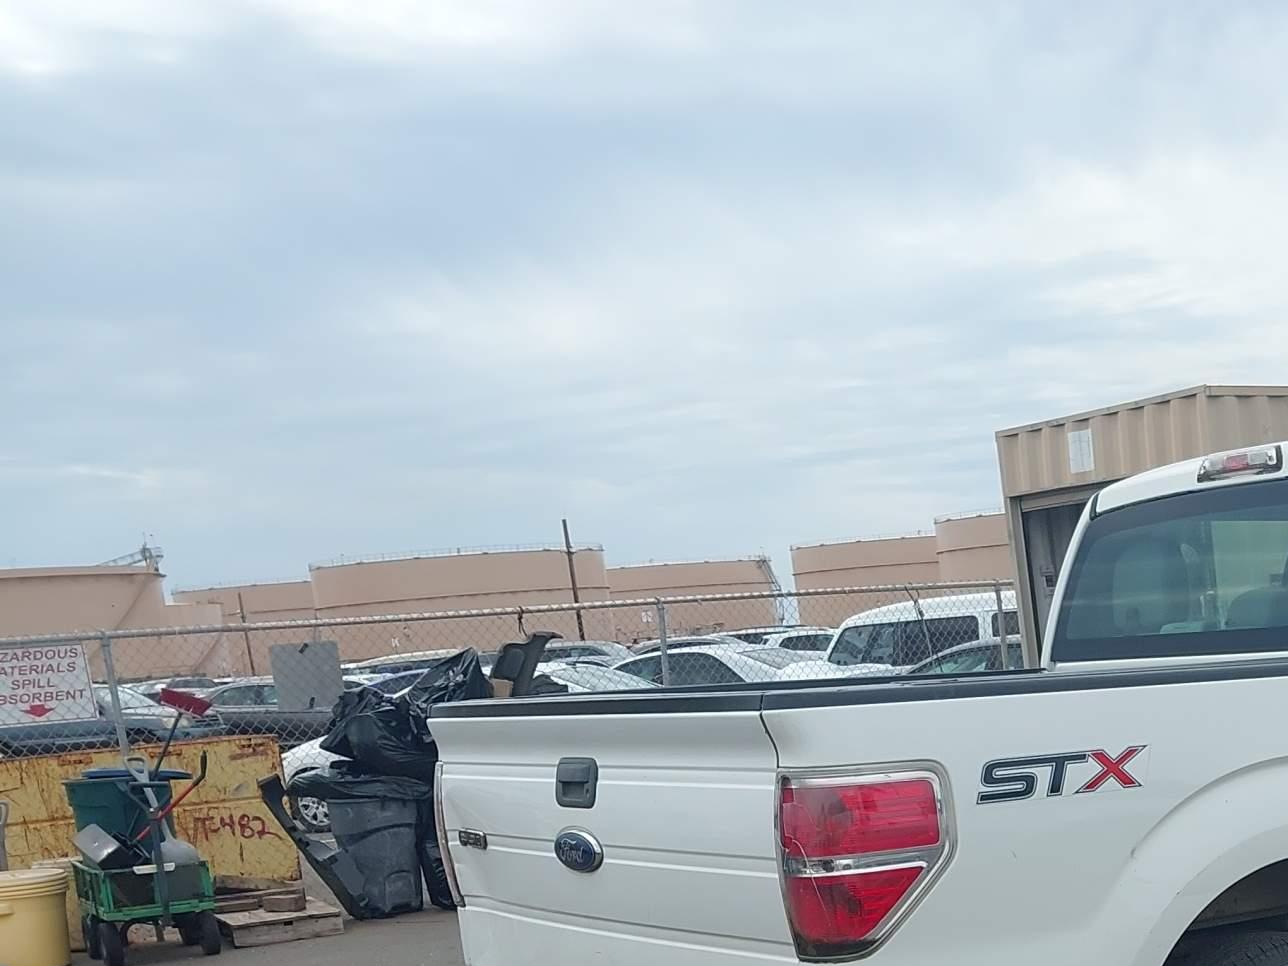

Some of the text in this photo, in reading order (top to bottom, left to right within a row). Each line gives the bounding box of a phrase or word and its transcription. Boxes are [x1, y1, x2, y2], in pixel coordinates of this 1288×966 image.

[11, 677, 56, 691] SPILL
[0, 689, 87, 706] BSORBENT
[976, 745, 1148, 805] STX
[559, 838, 585, 864] Ford
